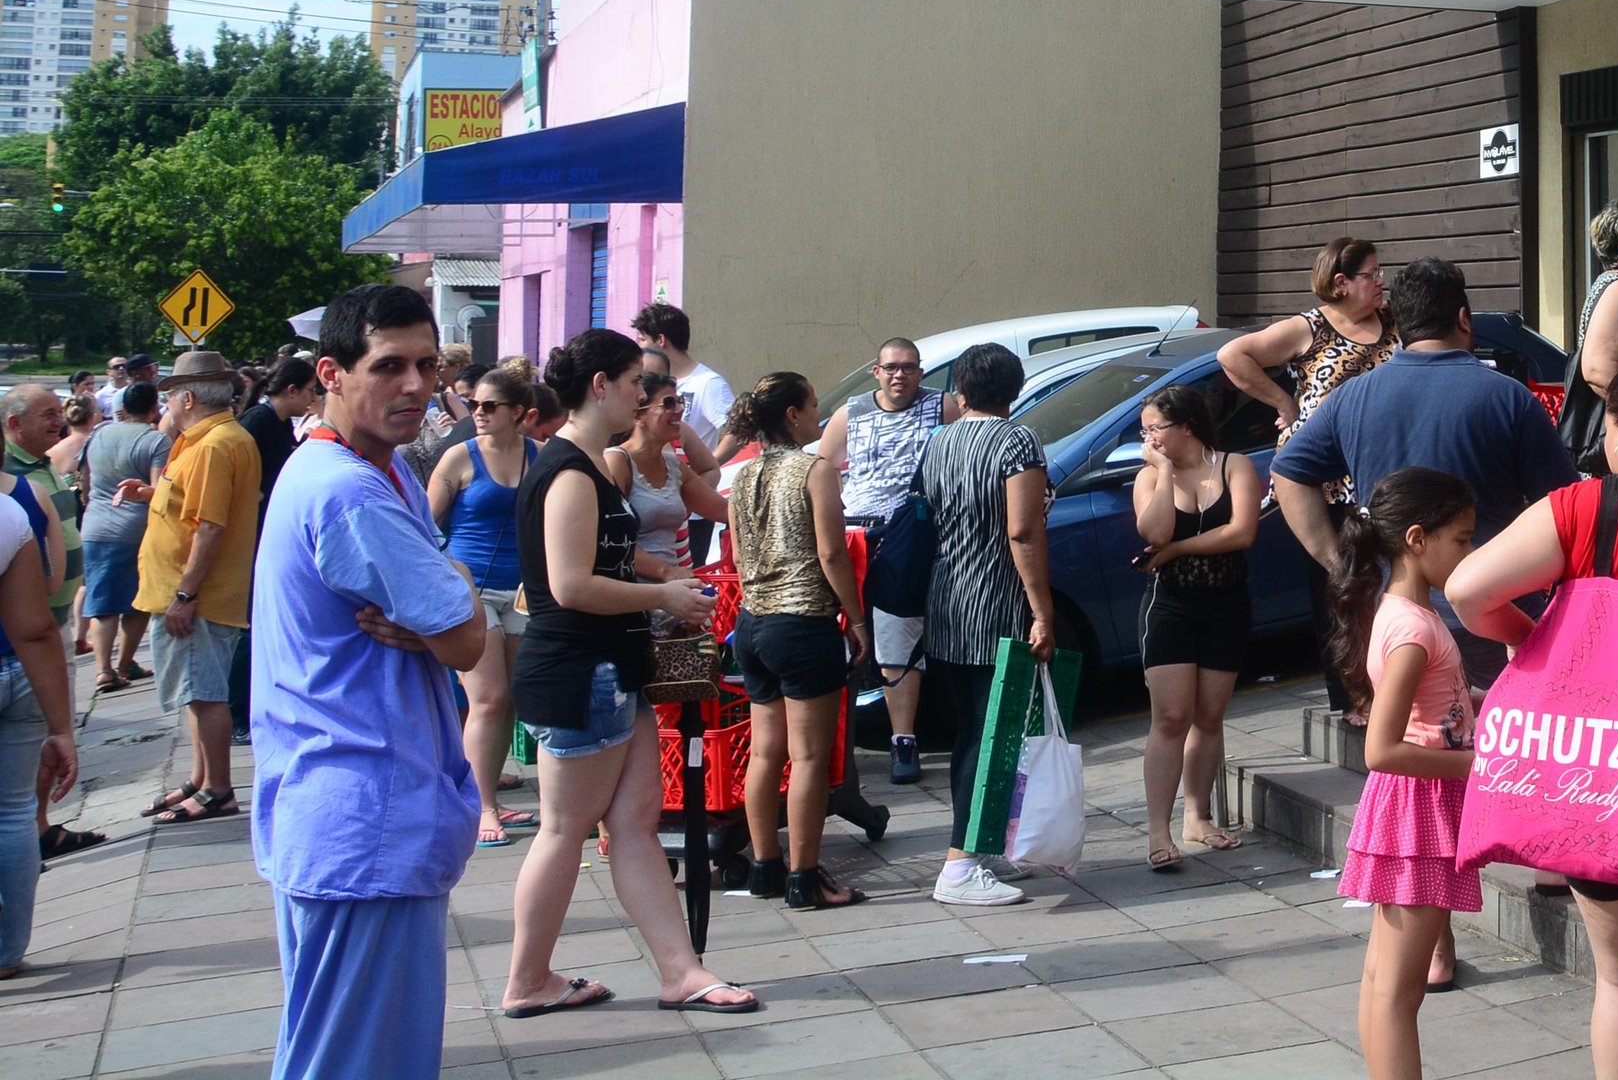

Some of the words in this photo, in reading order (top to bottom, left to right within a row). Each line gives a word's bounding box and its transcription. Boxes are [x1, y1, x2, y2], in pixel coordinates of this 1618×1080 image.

[430, 94, 502, 119] ESTACIO
[1474, 753, 1488, 777] by
[1478, 757, 1541, 797] Lalá
